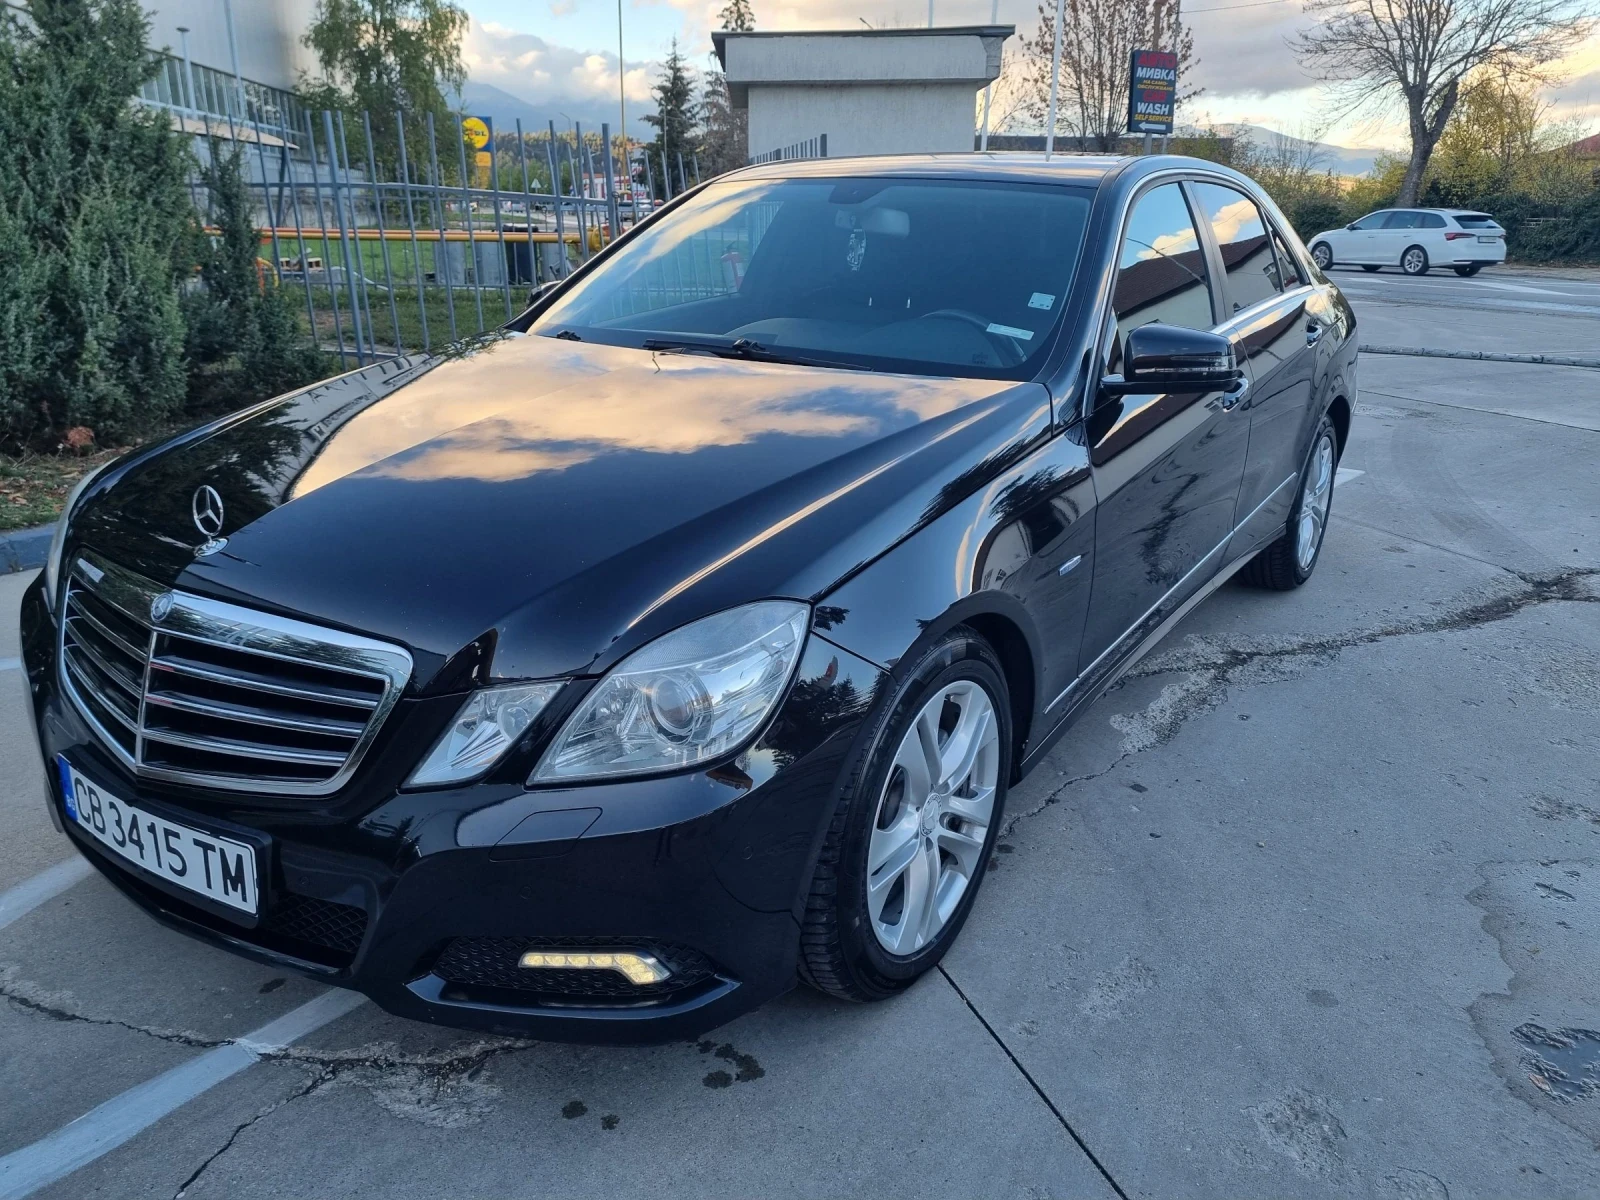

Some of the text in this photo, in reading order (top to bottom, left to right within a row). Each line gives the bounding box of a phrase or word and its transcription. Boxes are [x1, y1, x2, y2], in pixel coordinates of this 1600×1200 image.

[1138, 52, 1176, 68] АВТО
[1136, 67, 1175, 80] МИВКА
[1143, 90, 1167, 102] CAR
[1137, 102, 1170, 115] WASH
[1149, 114, 1172, 122] SERVICE
